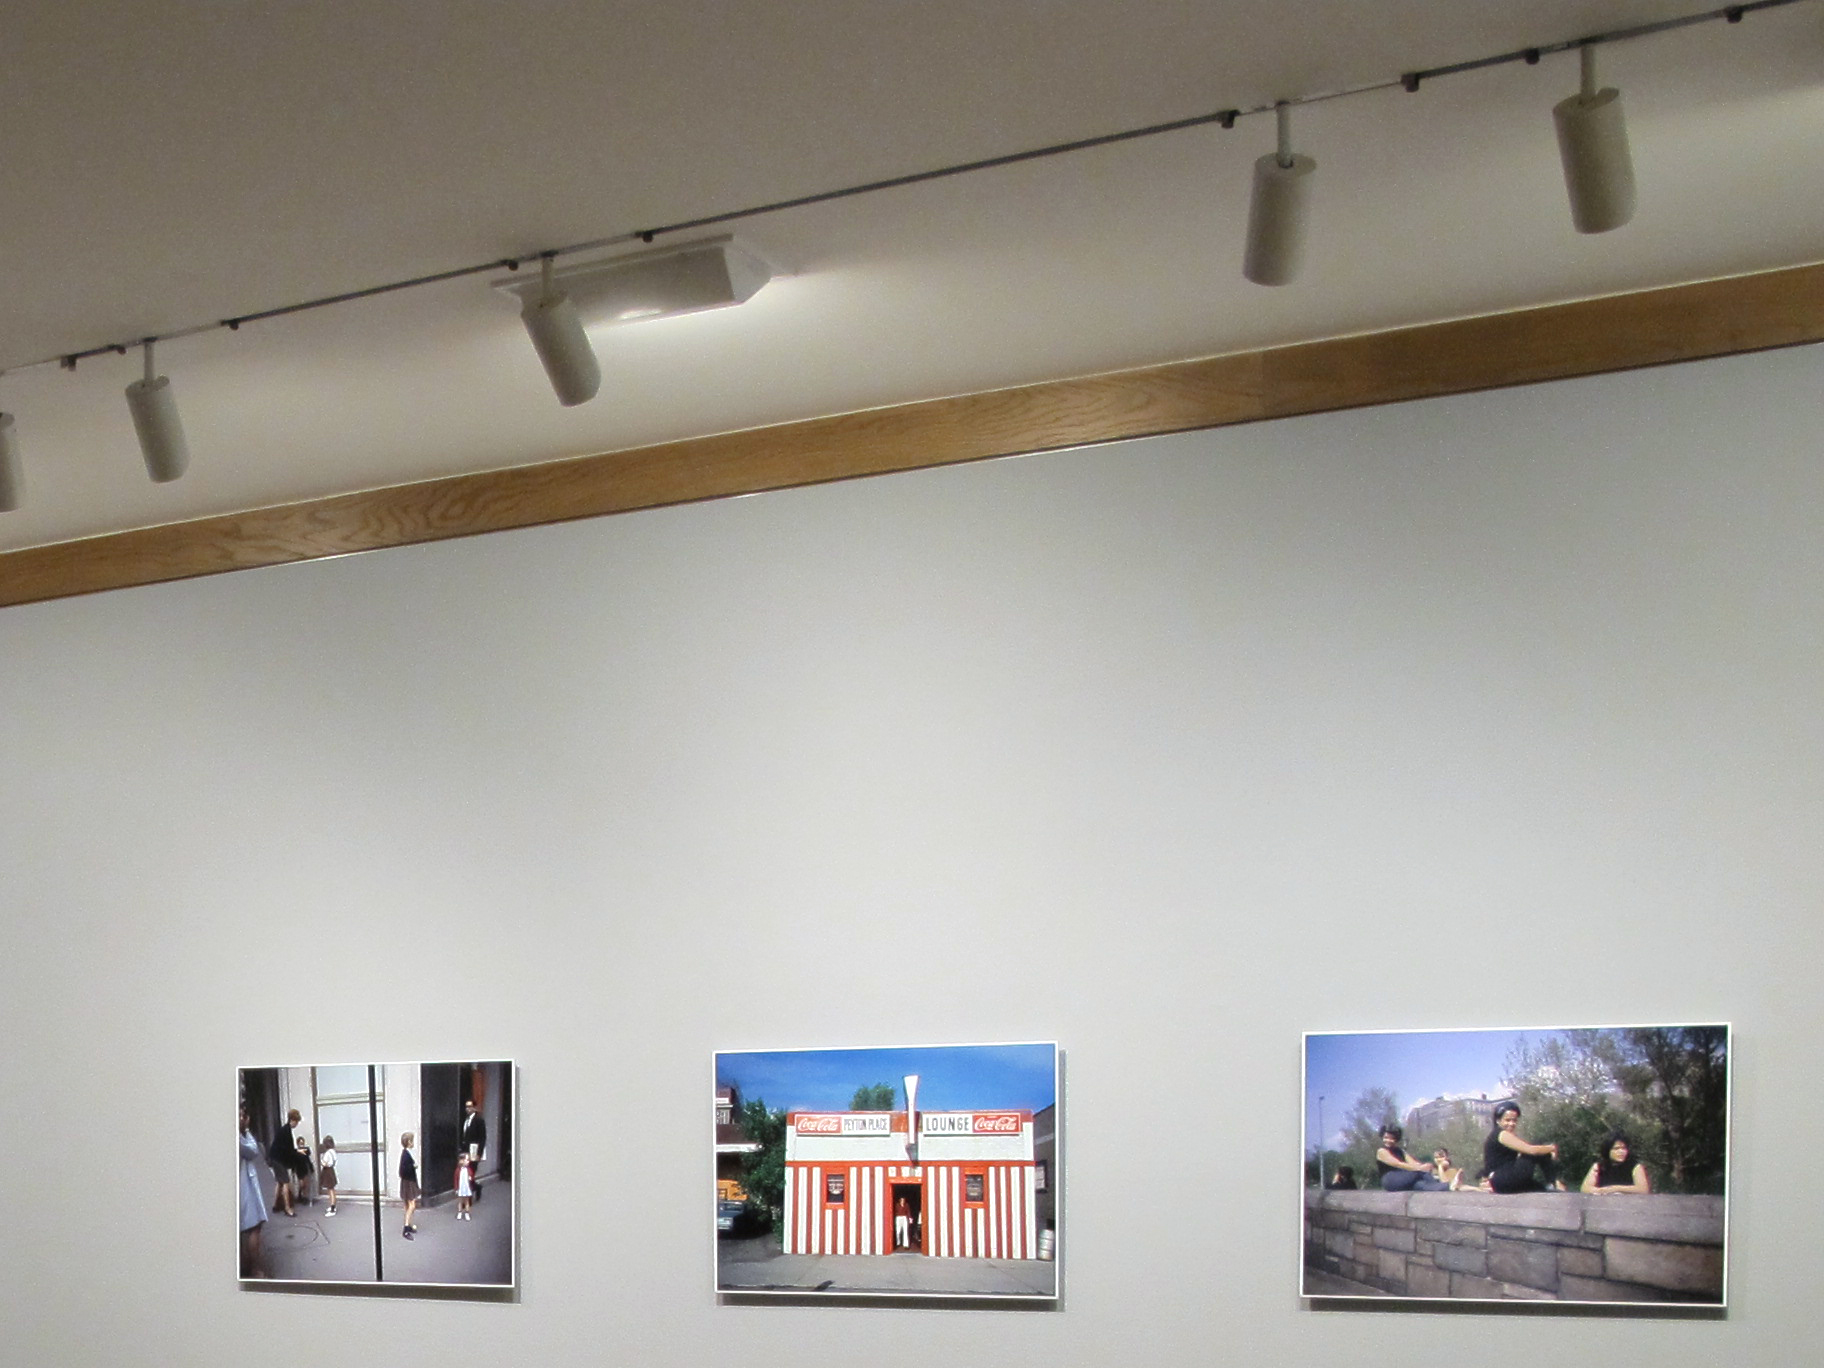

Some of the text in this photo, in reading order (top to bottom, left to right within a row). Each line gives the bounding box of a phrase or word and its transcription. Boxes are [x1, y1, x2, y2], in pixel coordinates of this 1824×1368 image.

[843, 1118, 888, 1132] PEYTON PLACE
[926, 1117, 970, 1132] LOUNGE
